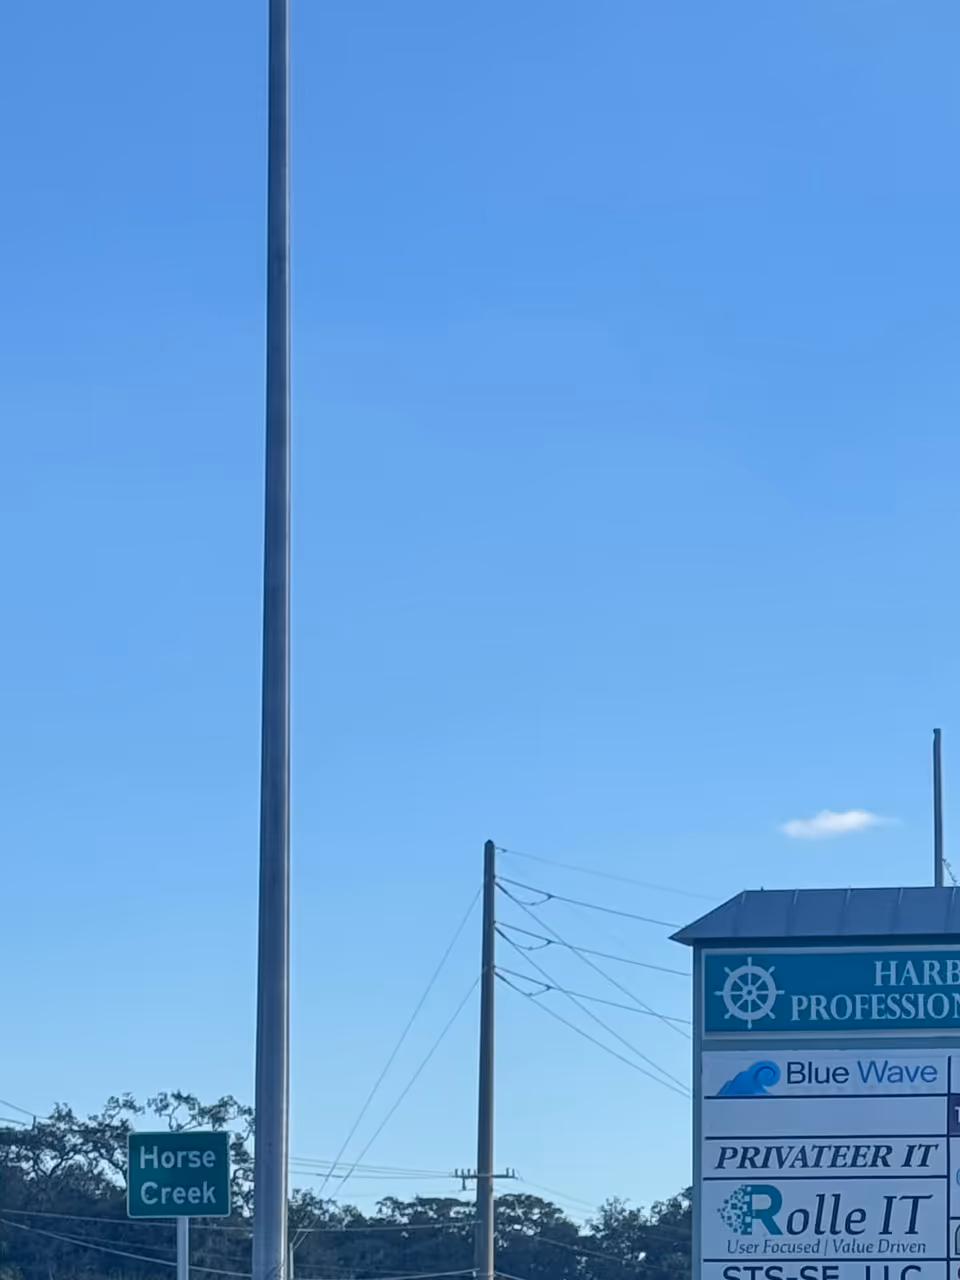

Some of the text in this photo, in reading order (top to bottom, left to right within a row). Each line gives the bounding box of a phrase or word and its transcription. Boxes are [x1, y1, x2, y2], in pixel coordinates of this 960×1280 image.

[786, 1059, 938, 1085] Blue Wave
[140, 1145, 216, 1169] Horse
[715, 1143, 939, 1170] PRIVATEER IT
[140, 1181, 217, 1205] Creek
[717, 1184, 933, 1236] Rolle IT
[727, 1238, 927, 1254] User Focused Value Driven
